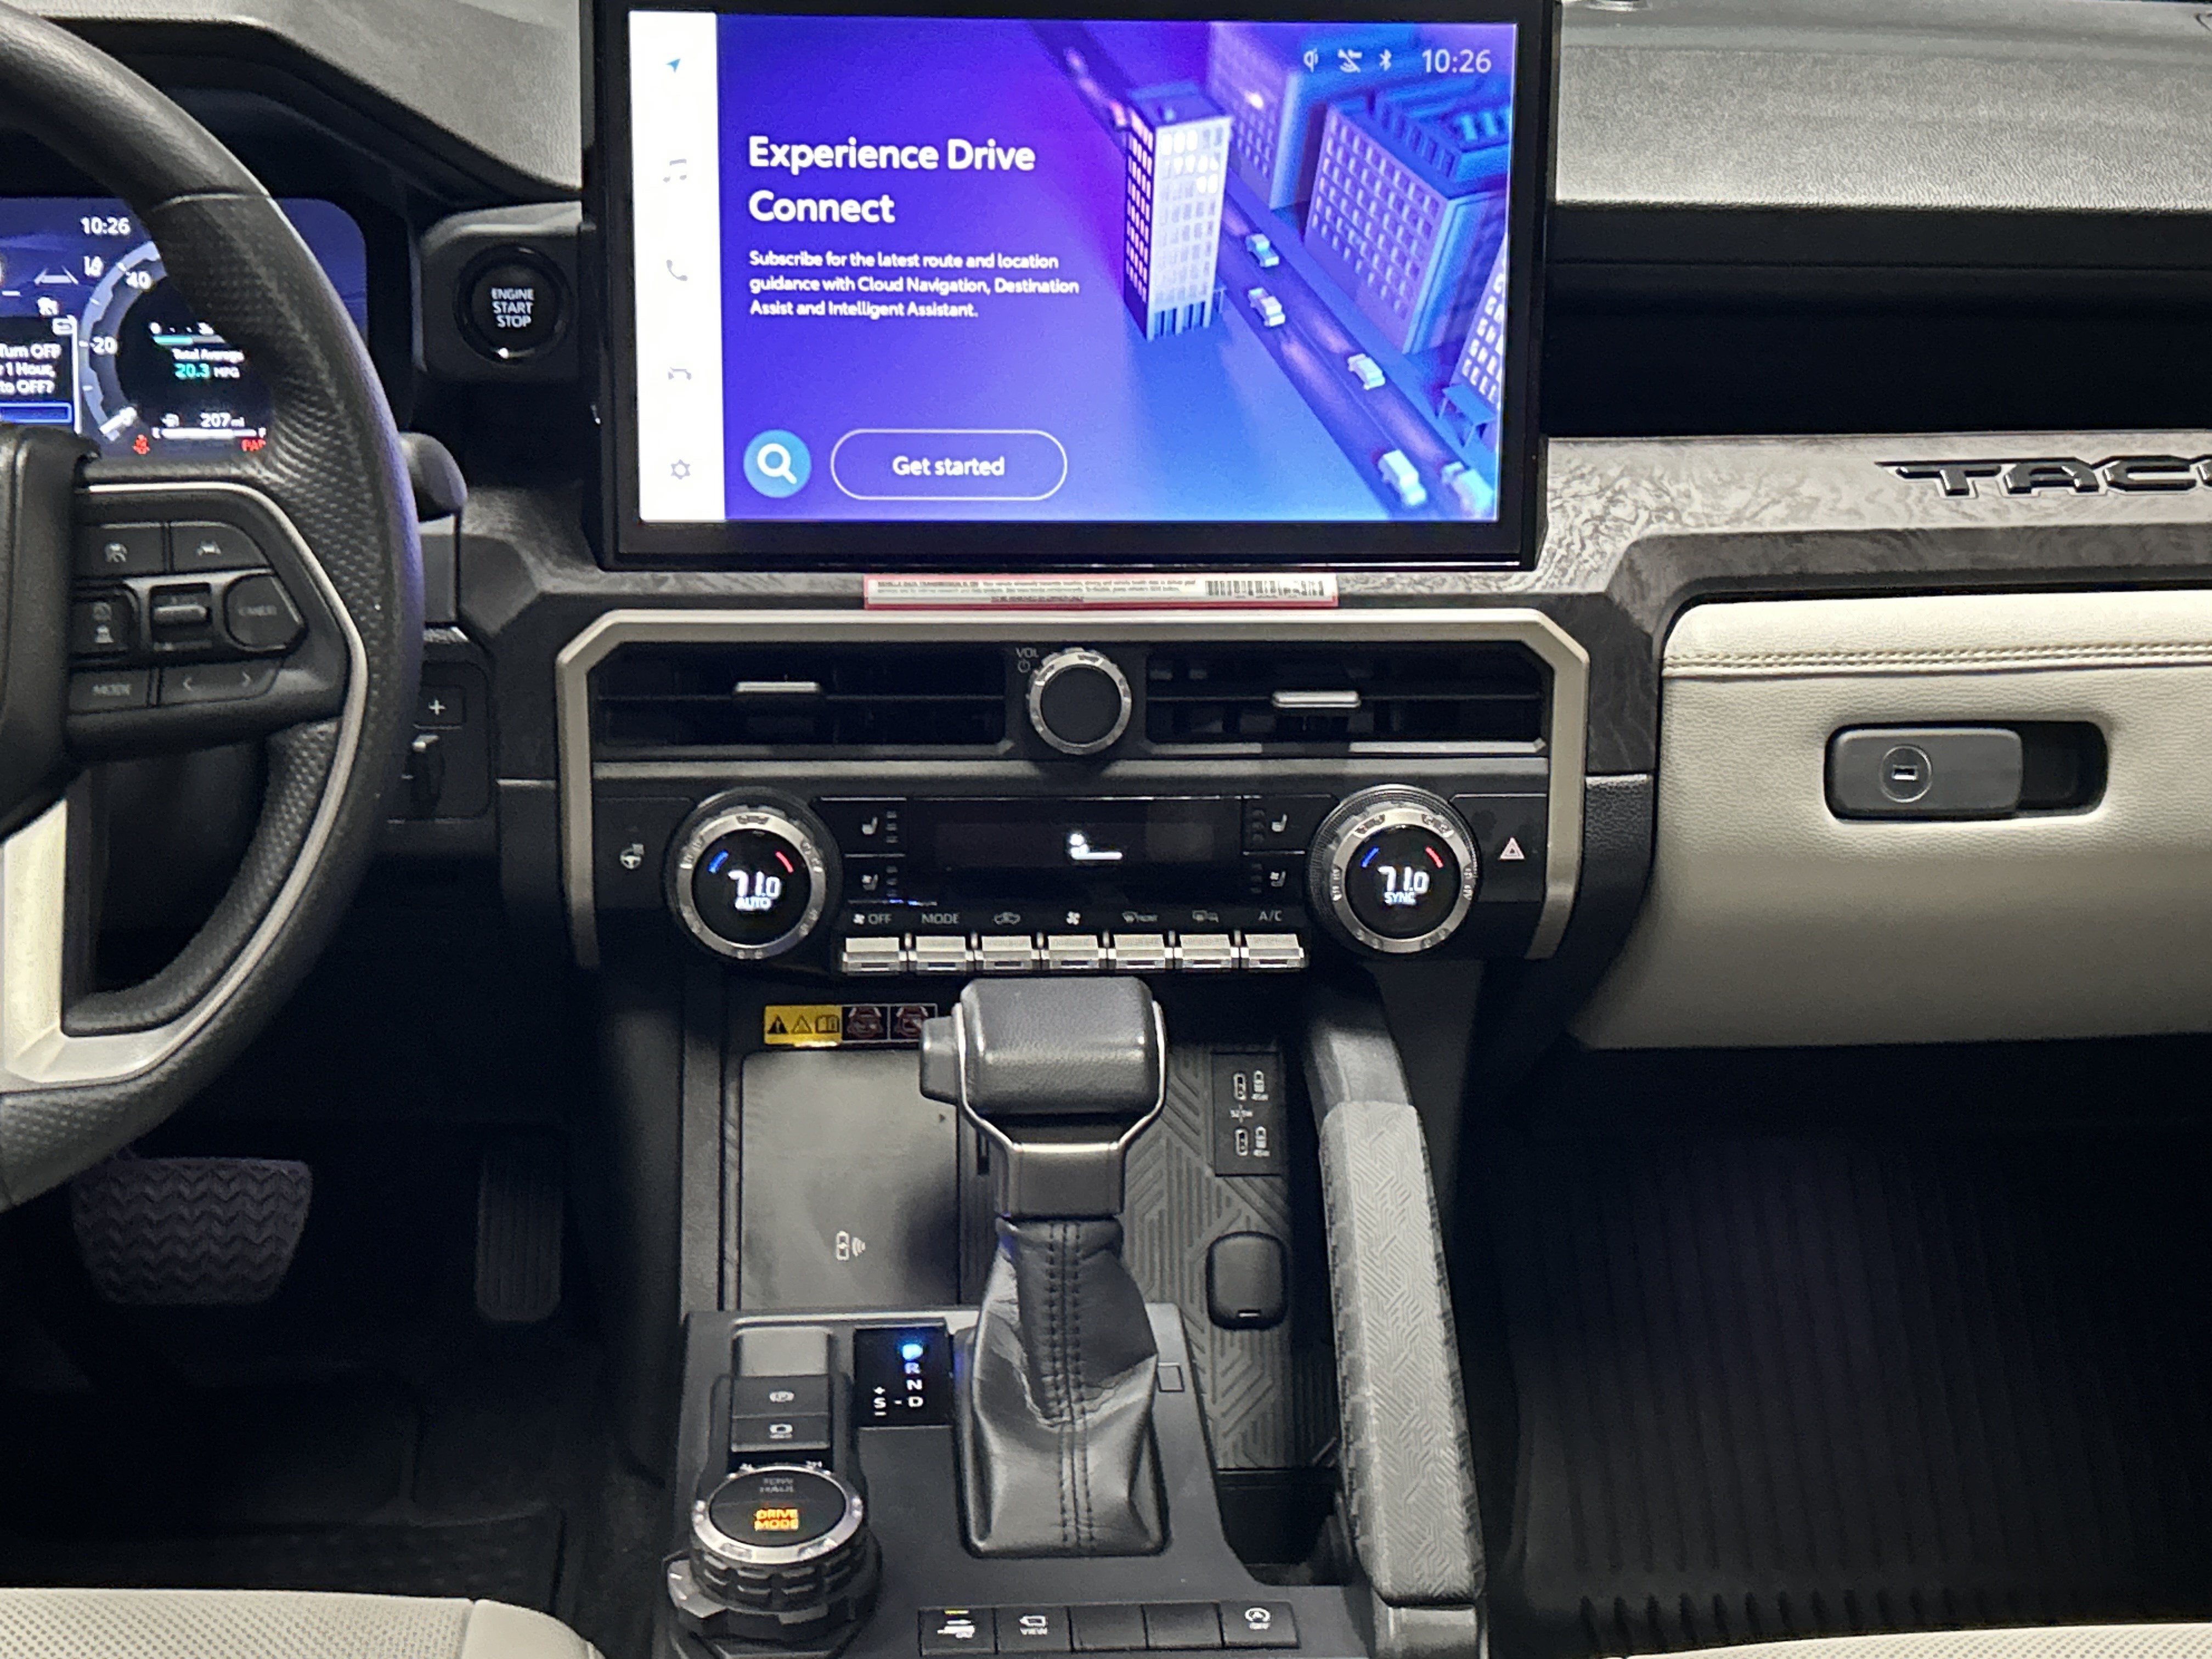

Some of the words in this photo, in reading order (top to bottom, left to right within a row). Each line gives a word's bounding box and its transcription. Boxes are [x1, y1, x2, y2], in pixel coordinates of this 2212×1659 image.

[1421, 49, 1492, 73] 10:26
[749, 136, 939, 176] Experience
[947, 138, 1036, 171] Drive
[749, 190, 895, 223] Connect
[80, 216, 131, 235] 10:26
[749, 250, 823, 267] Subscribe
[825, 250, 848, 267] for
[850, 251, 875, 268] the
[878, 251, 920, 268] latest
[923, 253, 963, 268] route
[966, 252, 995, 268] and
[997, 252, 1059, 269] location
[749, 275, 820, 294] guidance
[822, 276, 855, 291] with
[857, 276, 904, 292] Cloud
[907, 276, 991, 296] Navigation,
[994, 277, 1080, 294] Destination
[491, 288, 534, 301] ENGINE
[492, 301, 533, 314] START
[750, 299, 794, 315] Assist
[797, 300, 825, 315] and
[828, 300, 905, 320] Intelligent
[907, 301, 979, 318] Assistant.
[496, 315, 531, 328] STOP
[174, 363, 210, 379] 20.3
[213, 366, 240, 379] MPG
[200, 412, 231, 427] 207
[1875, 454, 2212, 498] TAC
[1015, 647, 1040, 658] VOL
[727, 869, 782, 899] 71.0
[1378, 866, 1430, 895] 71.0
[735, 896, 772, 911] AUTO
[1384, 891, 1417, 906] SYNC
[868, 913, 893, 924] OFF
[921, 913, 960, 924] MODE
[1259, 910, 1283, 922] A/C
[908, 1396, 924, 1408] D
[755, 1508, 798, 1520] DRIVE
[753, 1519, 799, 1532] MODE
